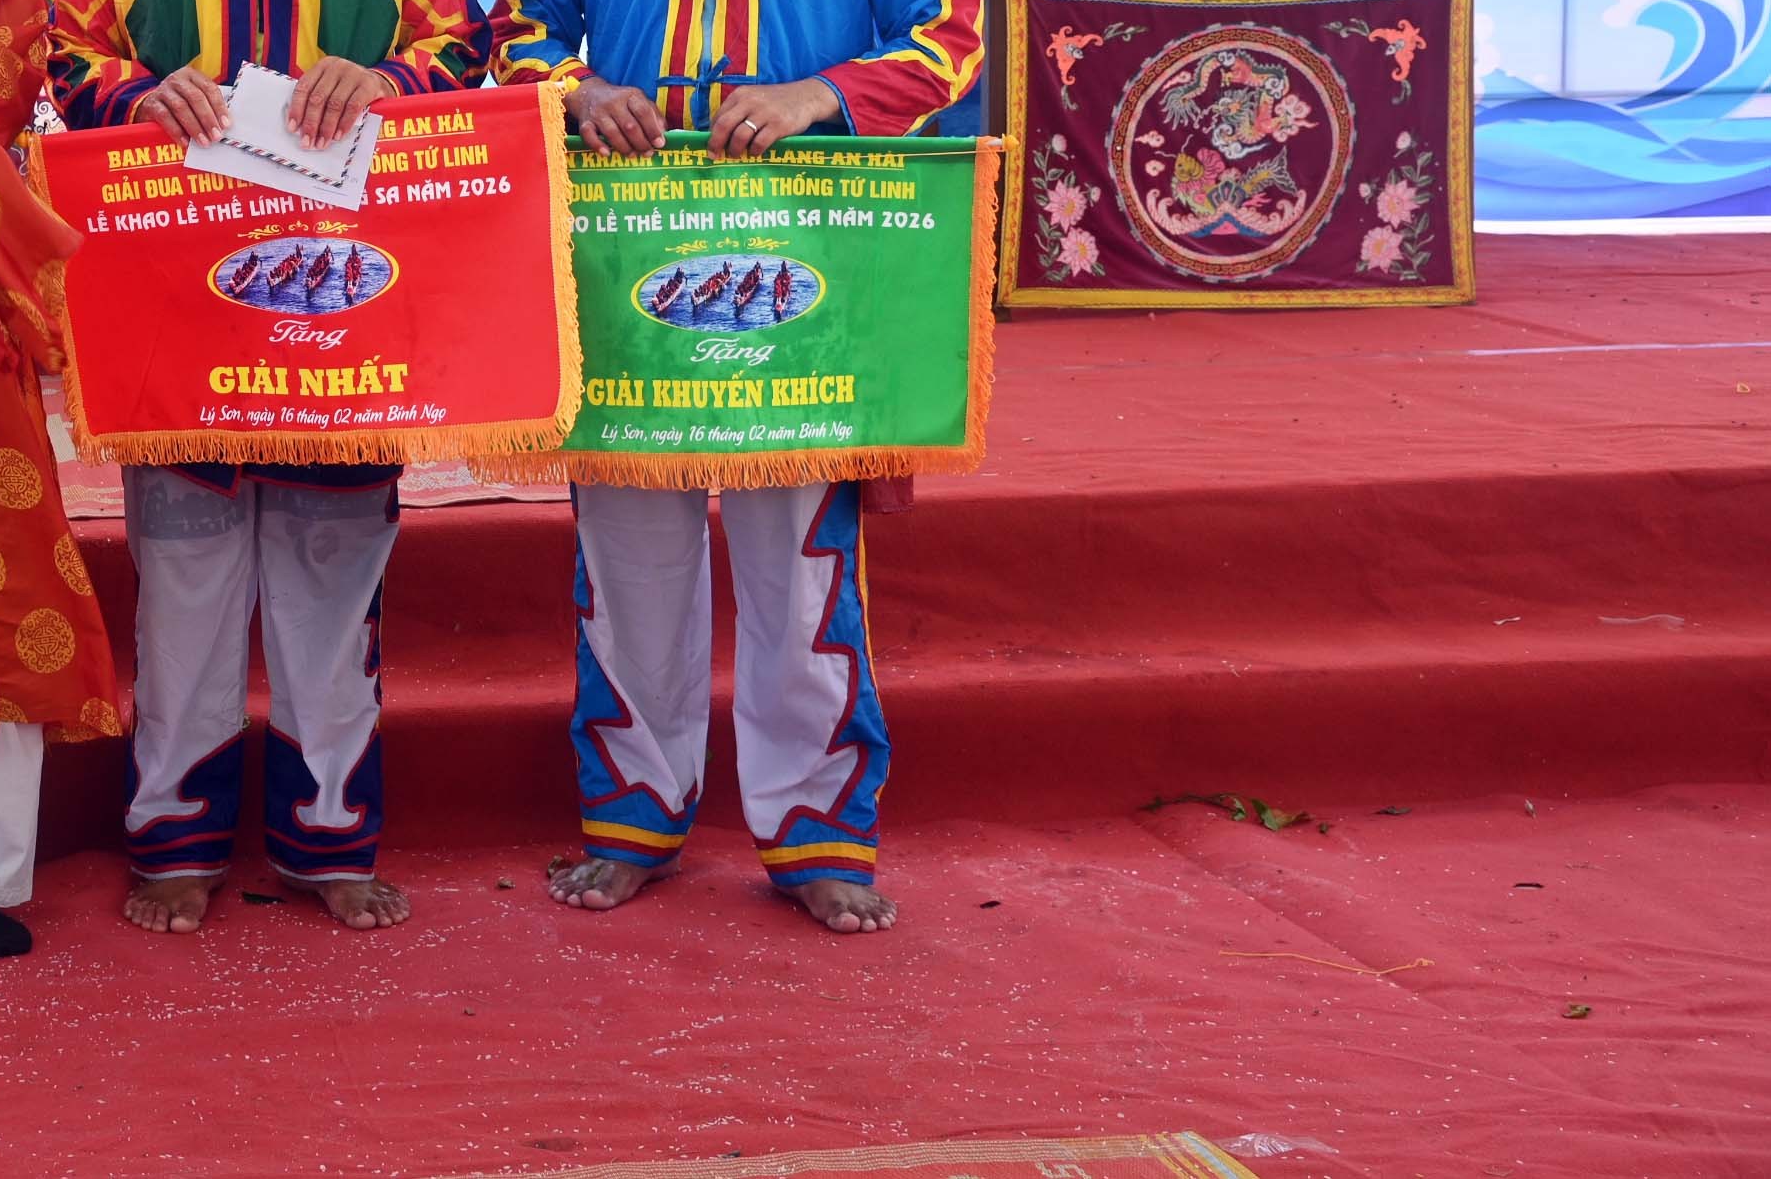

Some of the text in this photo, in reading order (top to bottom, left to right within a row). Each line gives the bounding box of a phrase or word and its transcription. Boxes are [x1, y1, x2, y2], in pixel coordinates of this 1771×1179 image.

[107, 146, 152, 170] BAN
[402, 117, 433, 138] AN
[436, 108, 476, 134] HẢI
[101, 144, 489, 205] GIẢI ĐUA ỐNG TỨ LINH
[830, 151, 862, 168] AN
[610, 174, 686, 203] THUYỀN
[690, 172, 765, 200] TRUYỀN
[768, 171, 834, 198] THỐNG
[839, 176, 866, 199] TỨ
[869, 179, 916, 201] LINH
[86, 175, 512, 234] LỄ KHAO LỀ THẾ LÍNH SA NĂM 2026
[596, 206, 936, 235] LỀ THẾ LÍNH HOÀNG SA NĂM 2026
[268, 318, 349, 351] Tặng
[689, 337, 777, 367] Tặng
[208, 354, 409, 398] GIẢI NHẤT
[585, 369, 856, 409] GIẢI KHUYẾN KHÍCH
[199, 403, 447, 430] Lý Sơn, ngày 16 tháng 02 năm Bính Ngọ
[600, 421, 854, 448] Lý Sơn, ngày 16 tháng 02 năm Bính Ngọ
